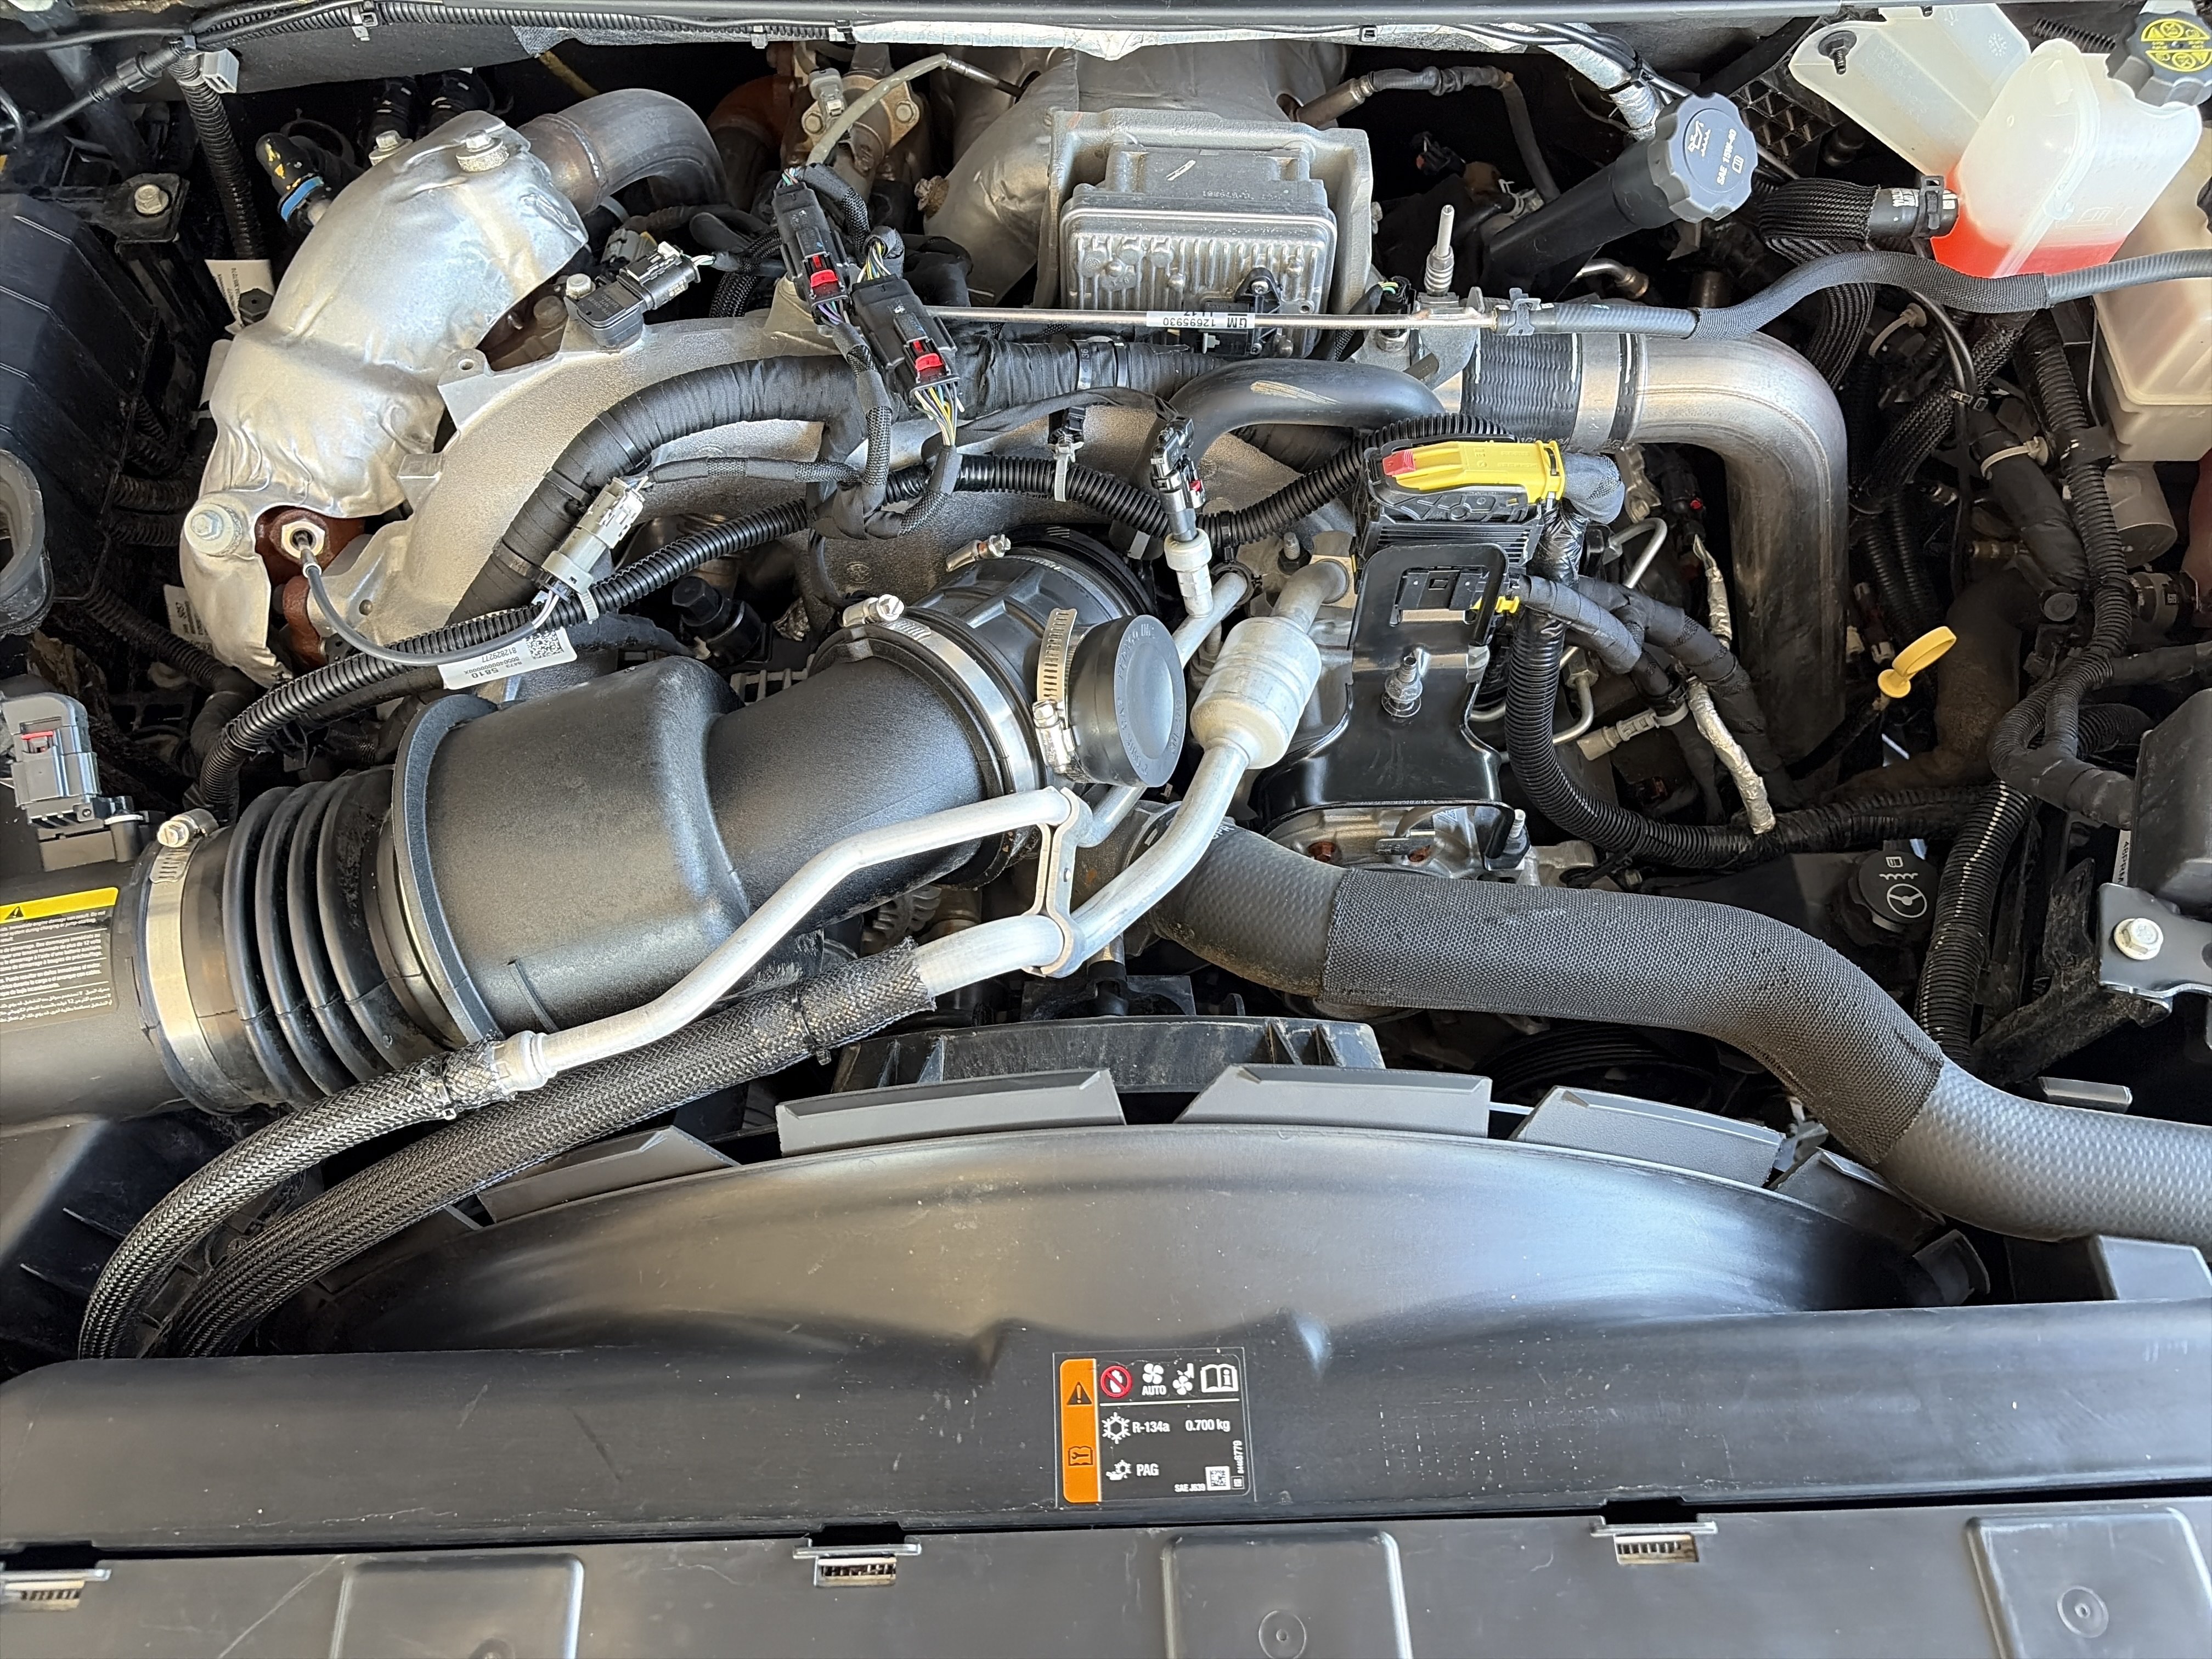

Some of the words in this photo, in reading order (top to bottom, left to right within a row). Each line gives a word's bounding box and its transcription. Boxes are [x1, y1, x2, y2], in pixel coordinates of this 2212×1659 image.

[1717, 165, 1728, 185] SAE
[1723, 129, 1737, 163] 15W-40
[1163, 317, 1216, 327] 12695930
[1227, 317, 1247, 328] GM
[482, 647, 517, 663] 812829277
[471, 668, 499, 679] 5810
[1142, 1385, 1167, 1396] AUTO
[1132, 1421, 1170, 1433] R-134a
[1185, 1419, 1215, 1431] 0.700
[1216, 1419, 1231, 1432] kg
[1136, 1463, 1159, 1476] PAG
[1175, 1484, 1189, 1492] SAE
[1189, 1483, 1206, 1492] J639
